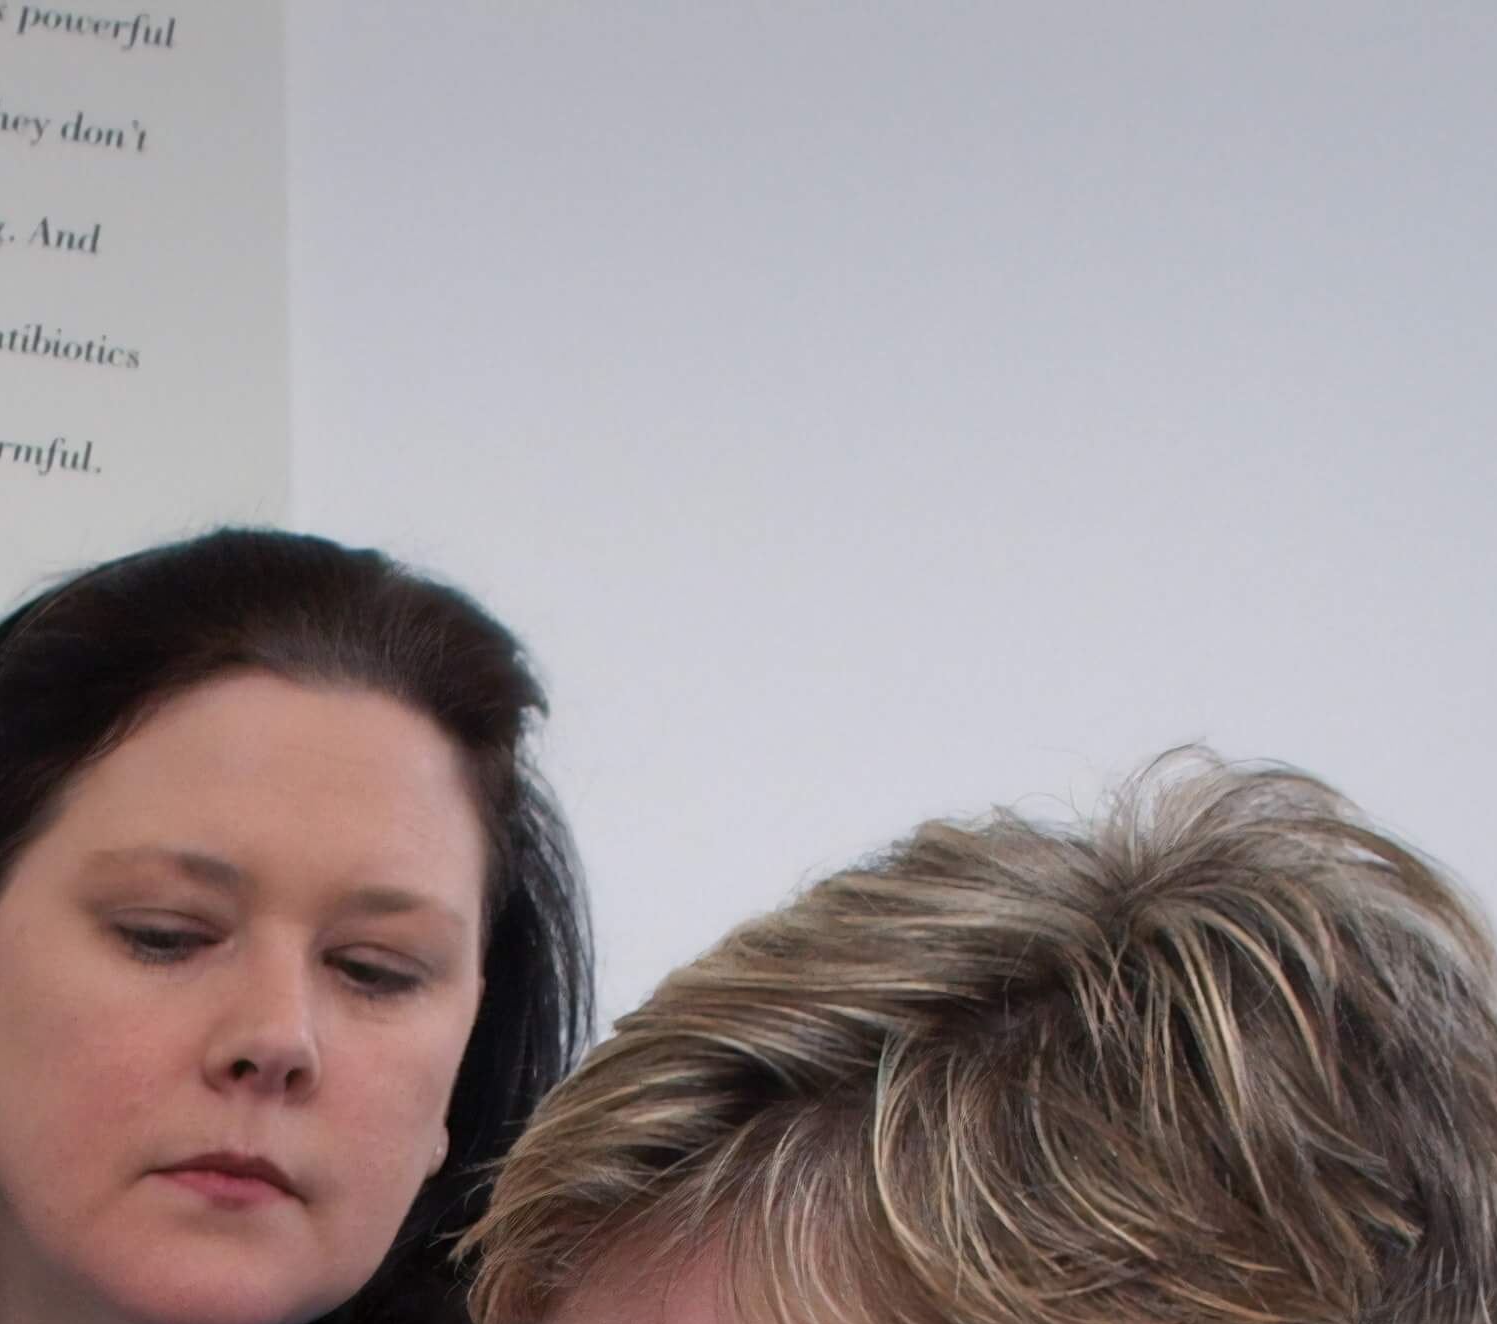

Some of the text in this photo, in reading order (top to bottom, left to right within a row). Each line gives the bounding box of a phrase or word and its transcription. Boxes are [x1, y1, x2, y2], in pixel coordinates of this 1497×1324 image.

[16, 5, 176, 50] powerful
[61, 112, 149, 153] don't
[28, 216, 102, 255] And
